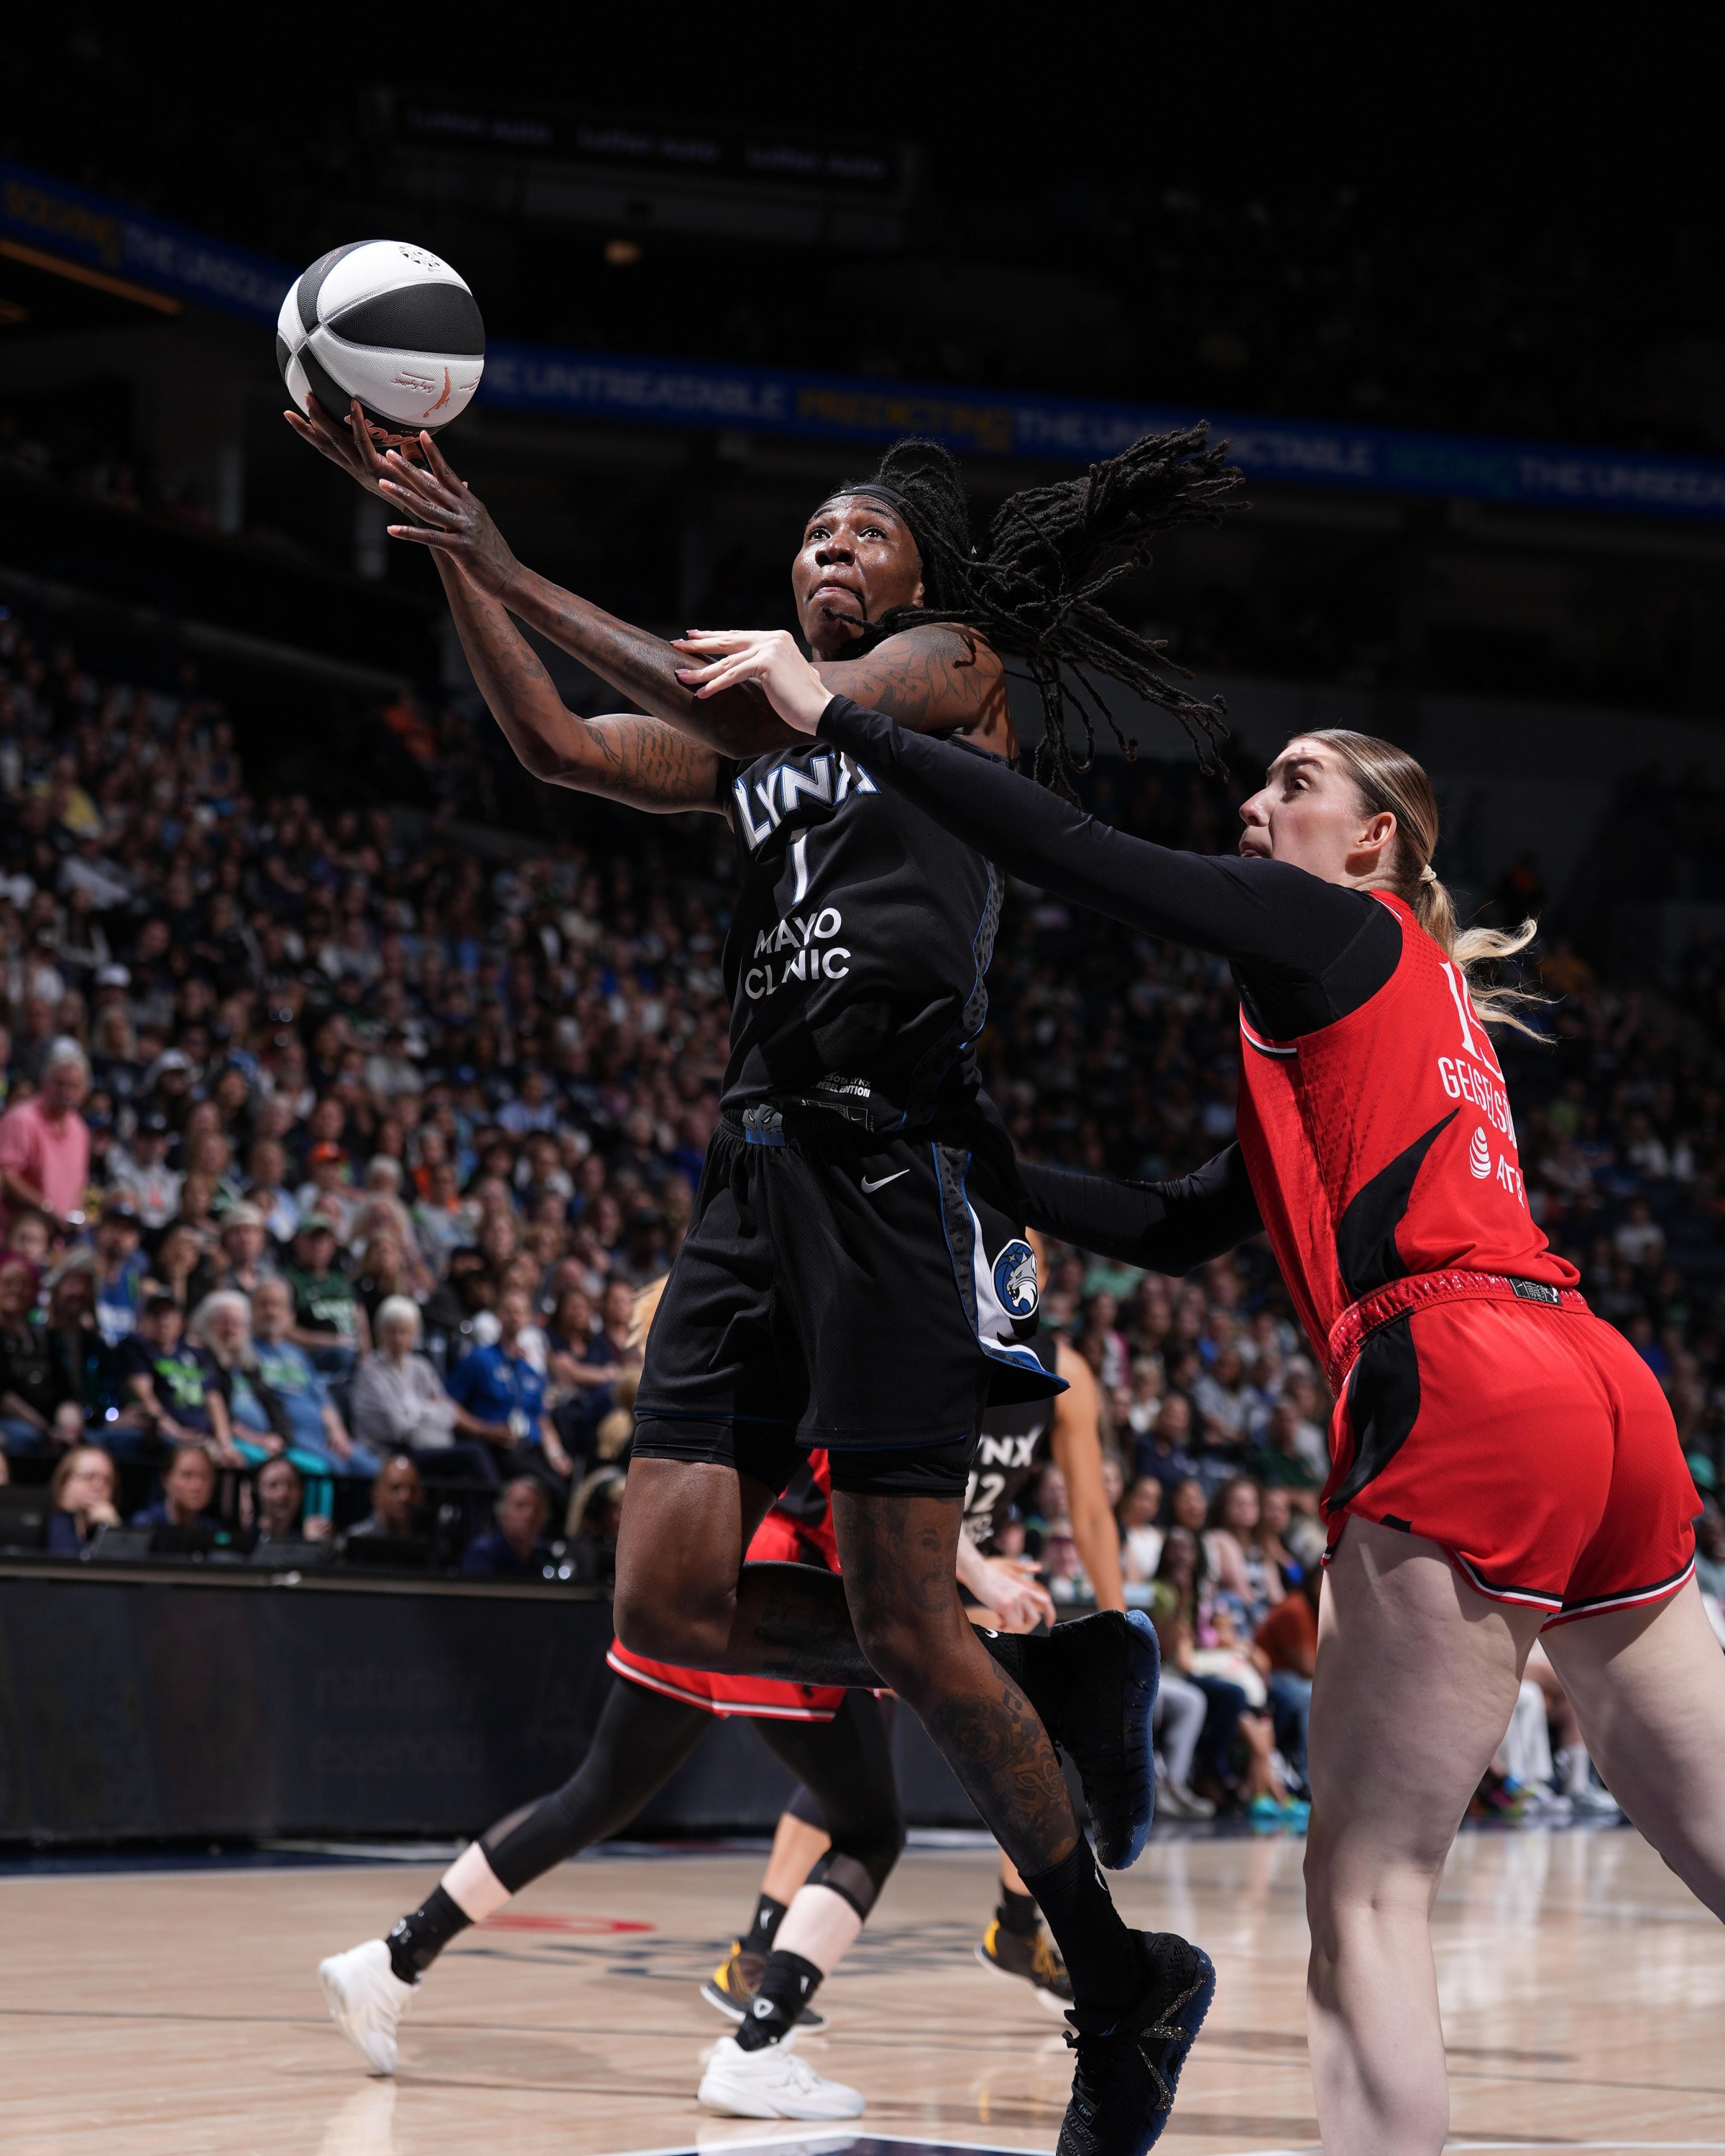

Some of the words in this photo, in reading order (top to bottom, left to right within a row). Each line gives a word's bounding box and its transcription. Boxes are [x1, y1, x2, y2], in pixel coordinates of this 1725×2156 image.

[485, 357, 518, 392] HE
[523, 364, 789, 420] UNTREATABLE
[1017, 408, 1087, 448] THE
[1090, 418, 1376, 476] UNICTABLE
[1517, 456, 1583, 496] THE
[731, 752, 882, 854] LYNX
[789, 828, 810, 906] 1
[754, 908, 842, 959] MAYO
[745, 947, 851, 1000] CLNIC
[816, 1082, 839, 1093] REBEL
[839, 1085, 871, 1097] EDITION
[850, 1077, 870, 1087] LYNX
[1496, 1154, 1524, 1208] AT&
[975, 1424, 1042, 1468] NX
